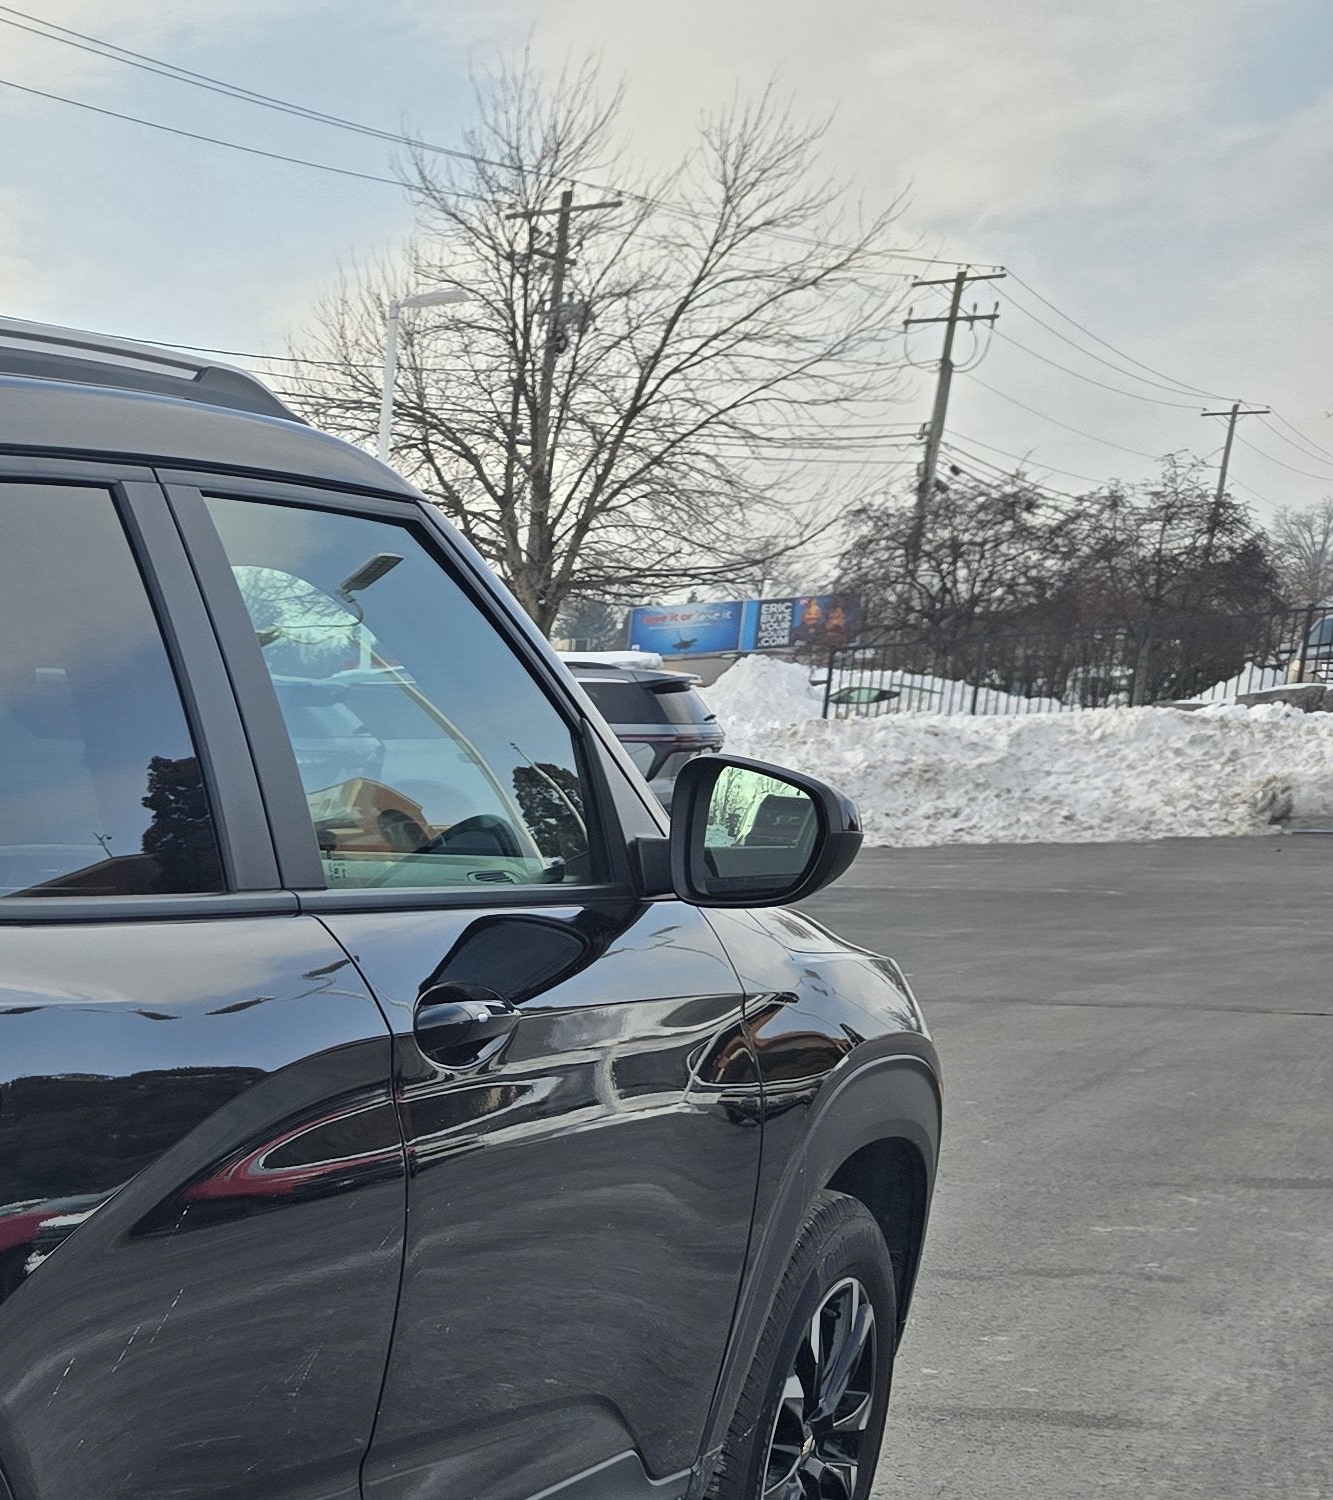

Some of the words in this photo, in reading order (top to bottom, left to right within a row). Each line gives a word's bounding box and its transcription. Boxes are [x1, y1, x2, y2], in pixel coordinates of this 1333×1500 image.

[761, 602, 793, 613] ERIC
[761, 612, 792, 623] BUYS
[761, 621, 791, 630] YOUR
